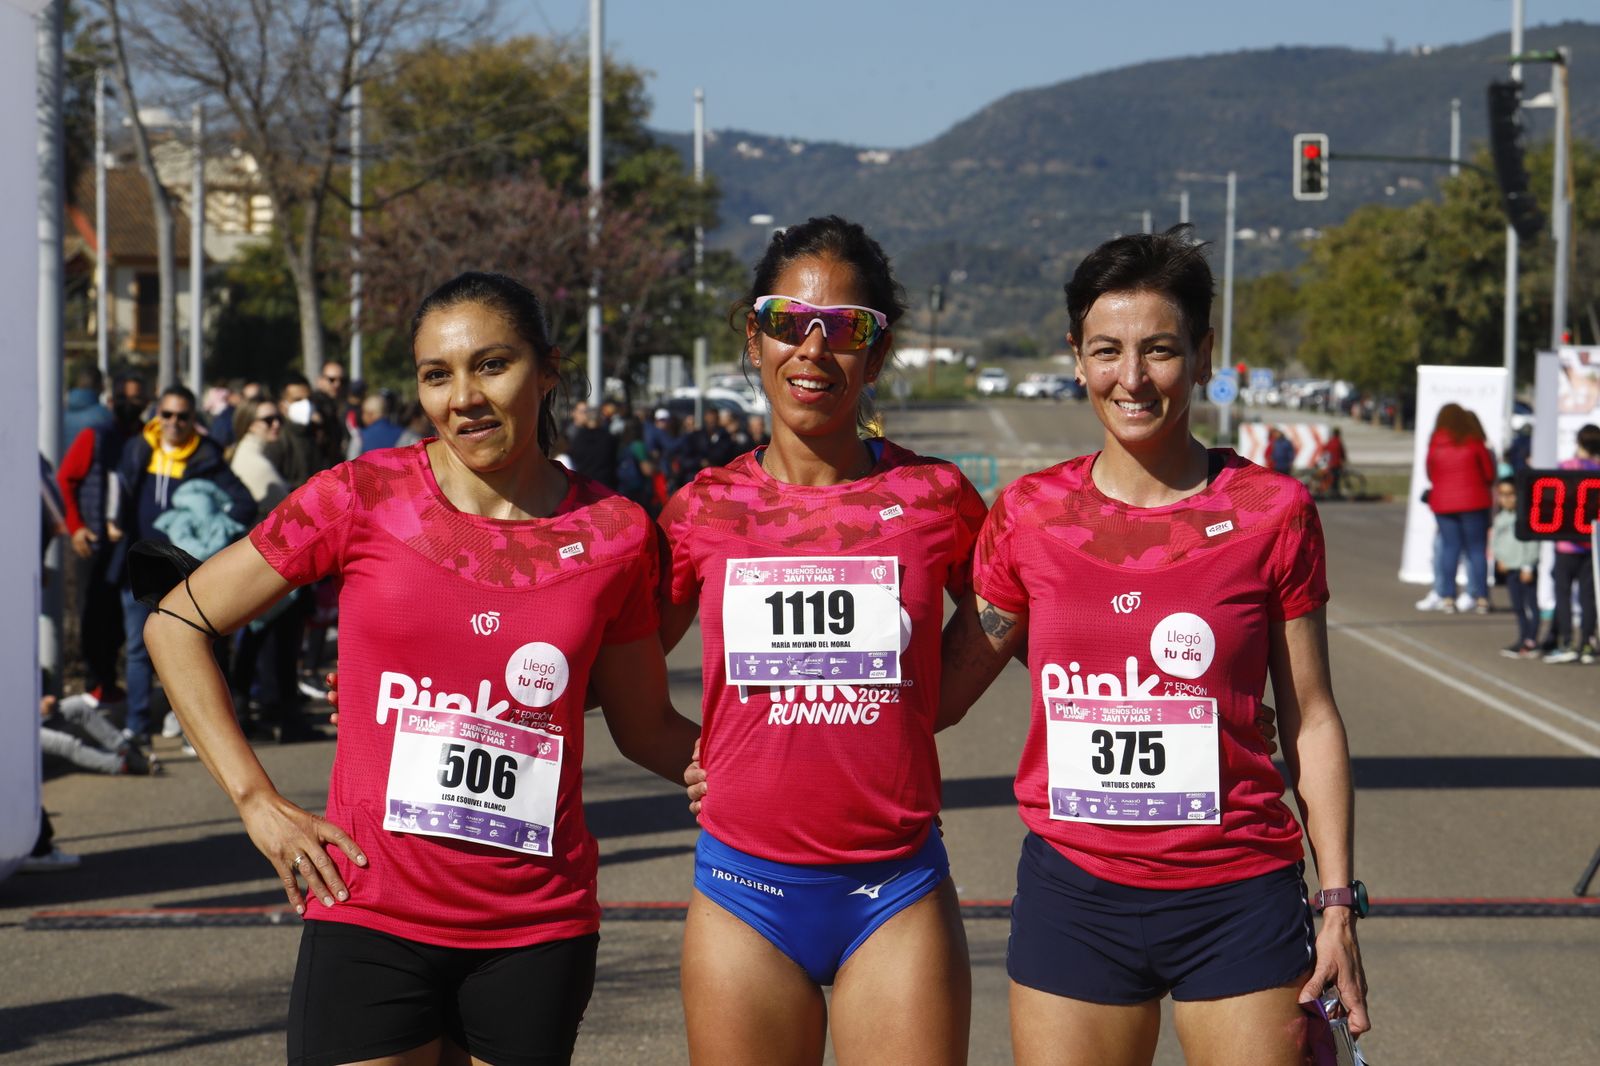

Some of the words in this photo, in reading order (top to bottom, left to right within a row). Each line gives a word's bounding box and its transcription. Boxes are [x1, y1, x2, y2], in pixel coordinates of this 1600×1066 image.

[815, 566, 832, 575] DÍAS
[765, 589, 855, 636] 1119
[792, 641, 817, 649] MOYANO
[830, 640, 851, 648] MORAL
[1167, 630, 1201, 647] Llegó
[1164, 647, 1177, 659] tu
[1181, 648, 1202, 662] día
[523, 658, 556, 676] Llegó
[518, 674, 531, 687] tu
[534, 677, 554, 691] día
[1175, 682, 1208, 696] EDICIÓN
[858, 687, 900, 703] 2022
[408, 715, 437, 728] Pink
[767, 702, 881, 725] RUNNING
[459, 729, 480, 739] JAVI
[486, 735, 506, 746] MAR
[462, 722, 489, 734] BUENOS
[489, 728, 505, 738] DÍAS
[1091, 729, 1166, 776] 375
[437, 743, 518, 800] 506
[1101, 781, 1129, 789] VIRTUDES
[1131, 781, 1156, 789] CORPAS
[441, 793, 455, 802] LISA
[456, 796, 483, 807] ESQUIVEL
[483, 800, 506, 812] BLANCO
[711, 867, 784, 897] TROTASIERRA
